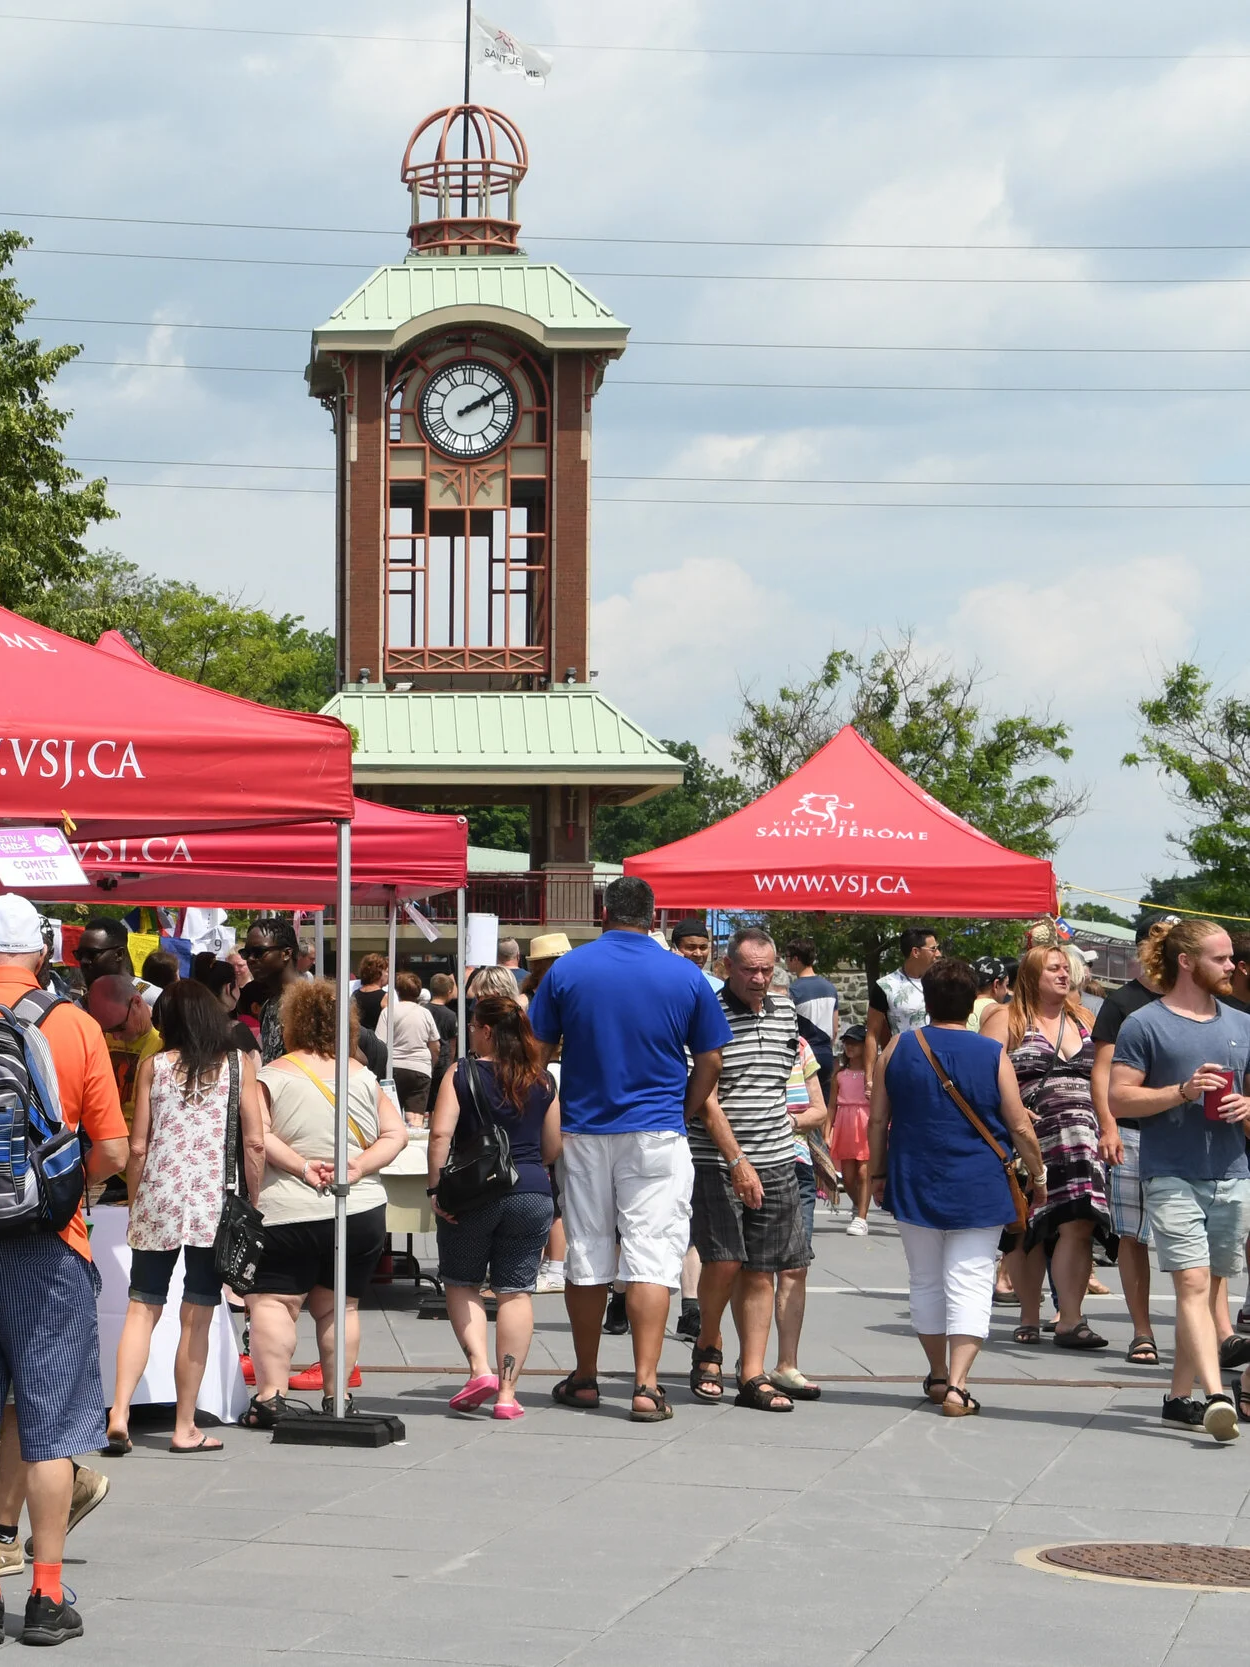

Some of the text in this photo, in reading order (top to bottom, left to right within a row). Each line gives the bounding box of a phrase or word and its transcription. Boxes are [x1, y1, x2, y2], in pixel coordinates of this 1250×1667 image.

[494, 404, 510, 415] III
[755, 826, 929, 841] SAINT-JÉRÔME
[13, 857, 59, 870] COMITÉ
[24, 869, 59, 881] HAÏTI
[753, 874, 912, 897] WWW.VSJ.CA
[214, 939, 222, 952] 9
